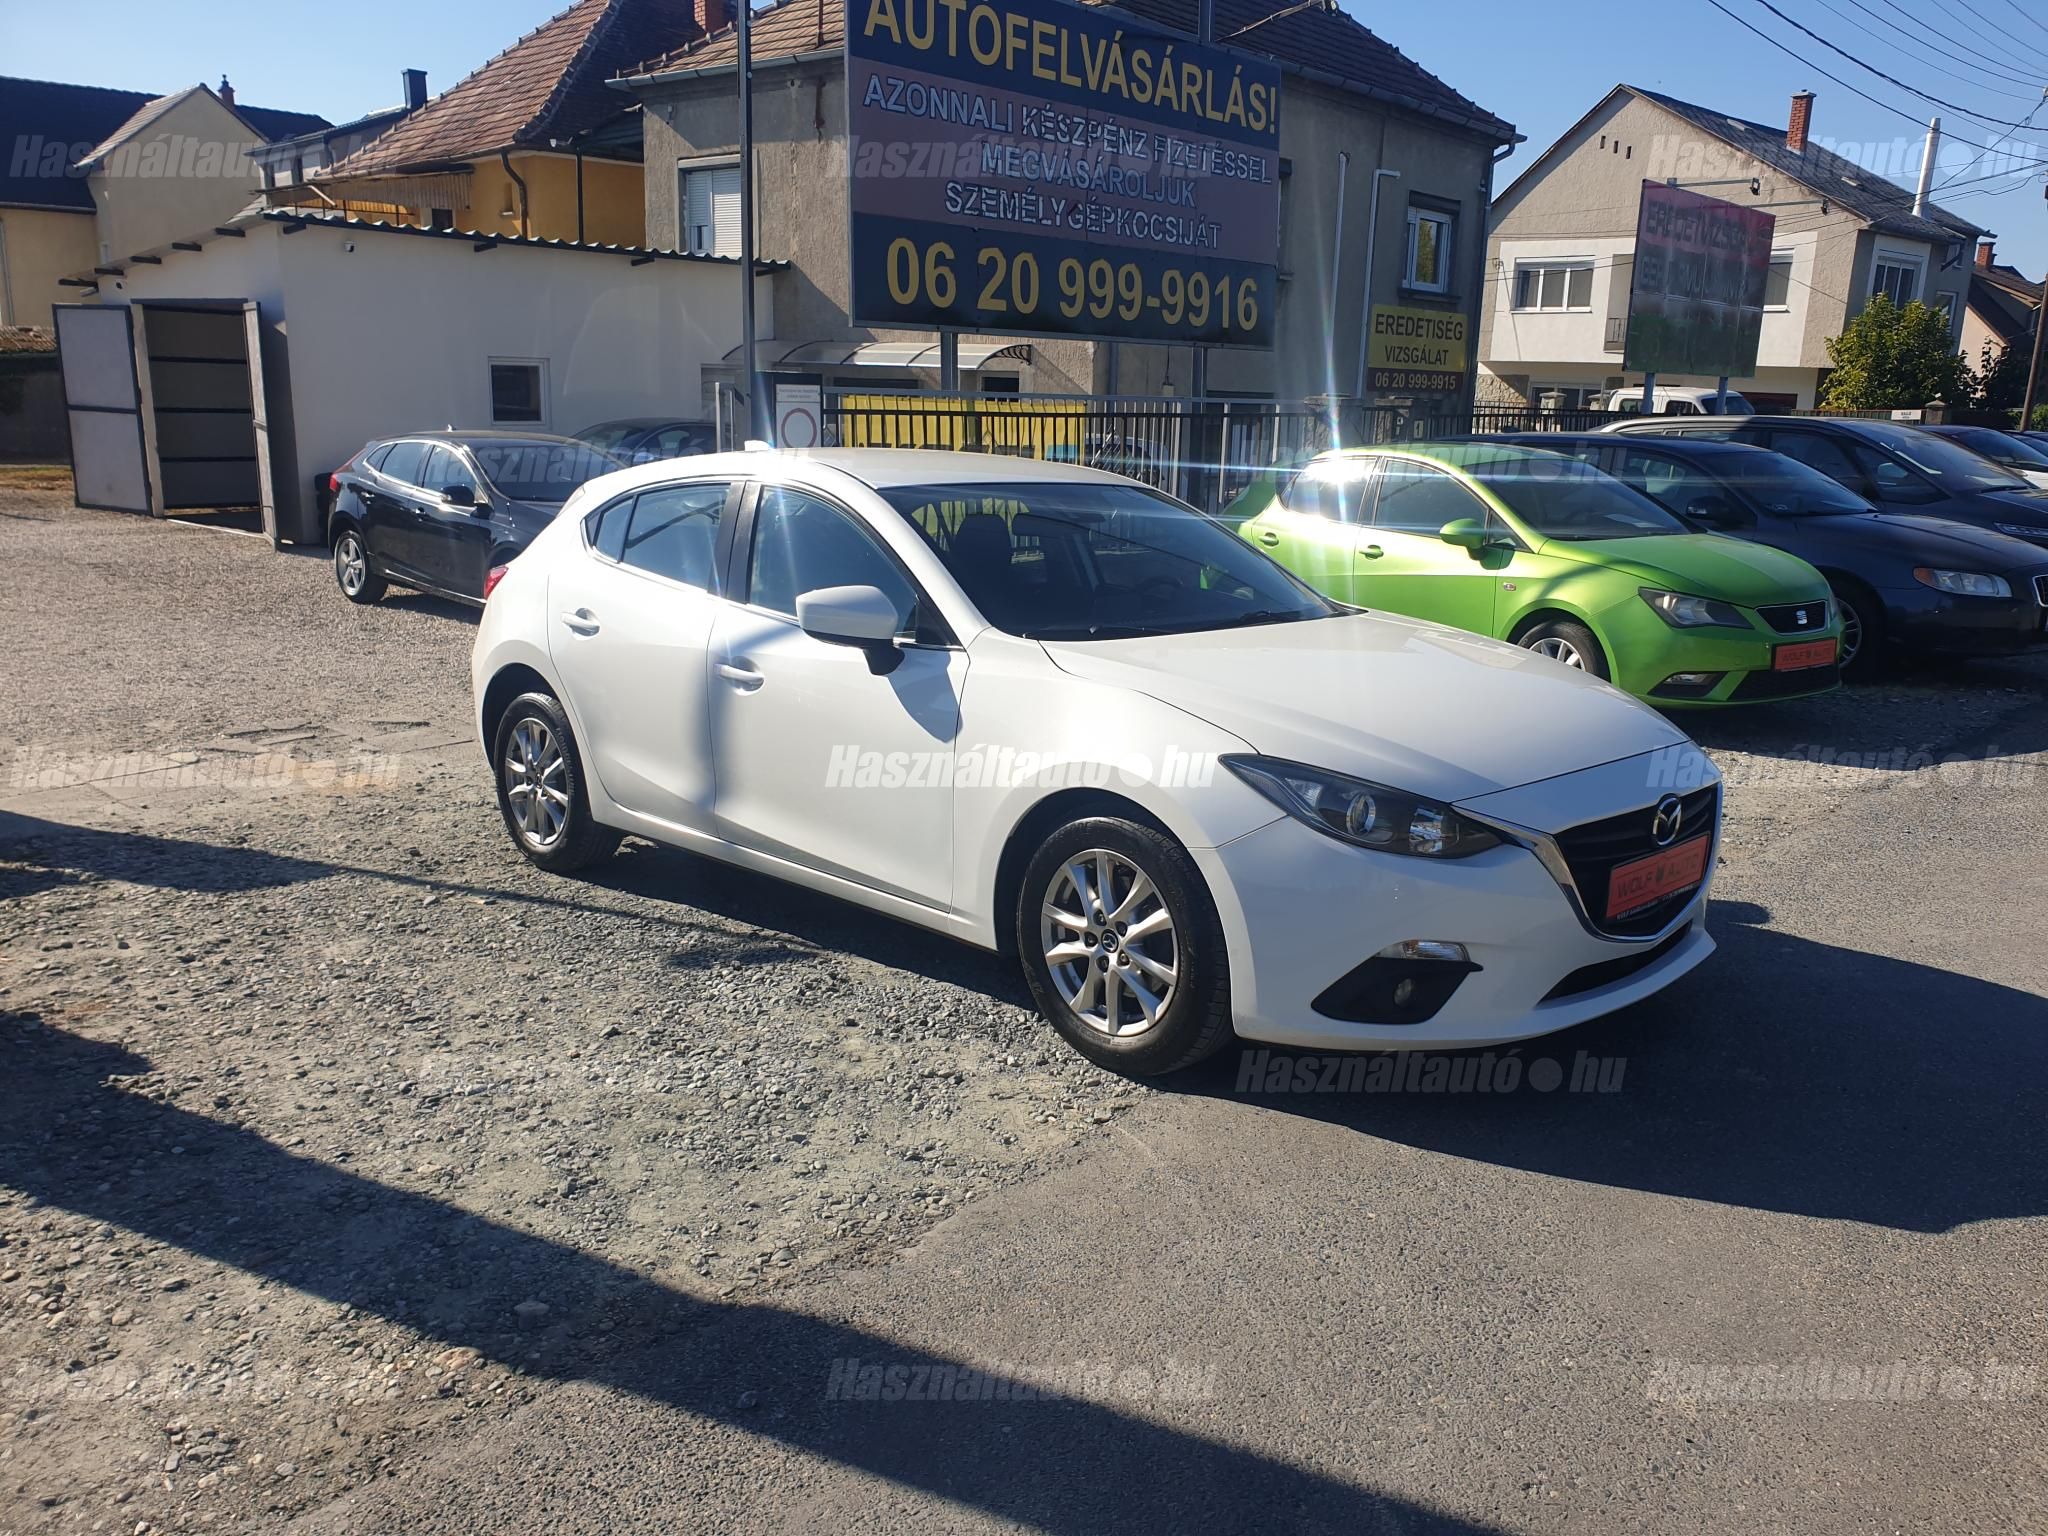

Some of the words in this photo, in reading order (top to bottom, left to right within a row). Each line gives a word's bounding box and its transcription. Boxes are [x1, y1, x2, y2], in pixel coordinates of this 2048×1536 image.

[863, 73, 1014, 133] AZONNALI
[1021, 103, 1149, 158] KÉSZPÉNZ
[1153, 134, 1272, 184] FIZETÉSSEL
[980, 142, 1198, 208] MEGVÁSÁROLJUK
[945, 181, 1222, 249] SZEMÉLYGÉPKOCSIJÁT
[886, 237, 957, 308] 06
[976, 246, 1040, 315] 20
[1057, 257, 1258, 331] 999-9916
[1375, 313, 1463, 341] EREDETISÉG
[1384, 344, 1449, 365] VIZSGÁLAT
[1375, 372, 1390, 387] 06
[1392, 373, 1406, 388] 20
[1408, 374, 1456, 390] 999-9915
